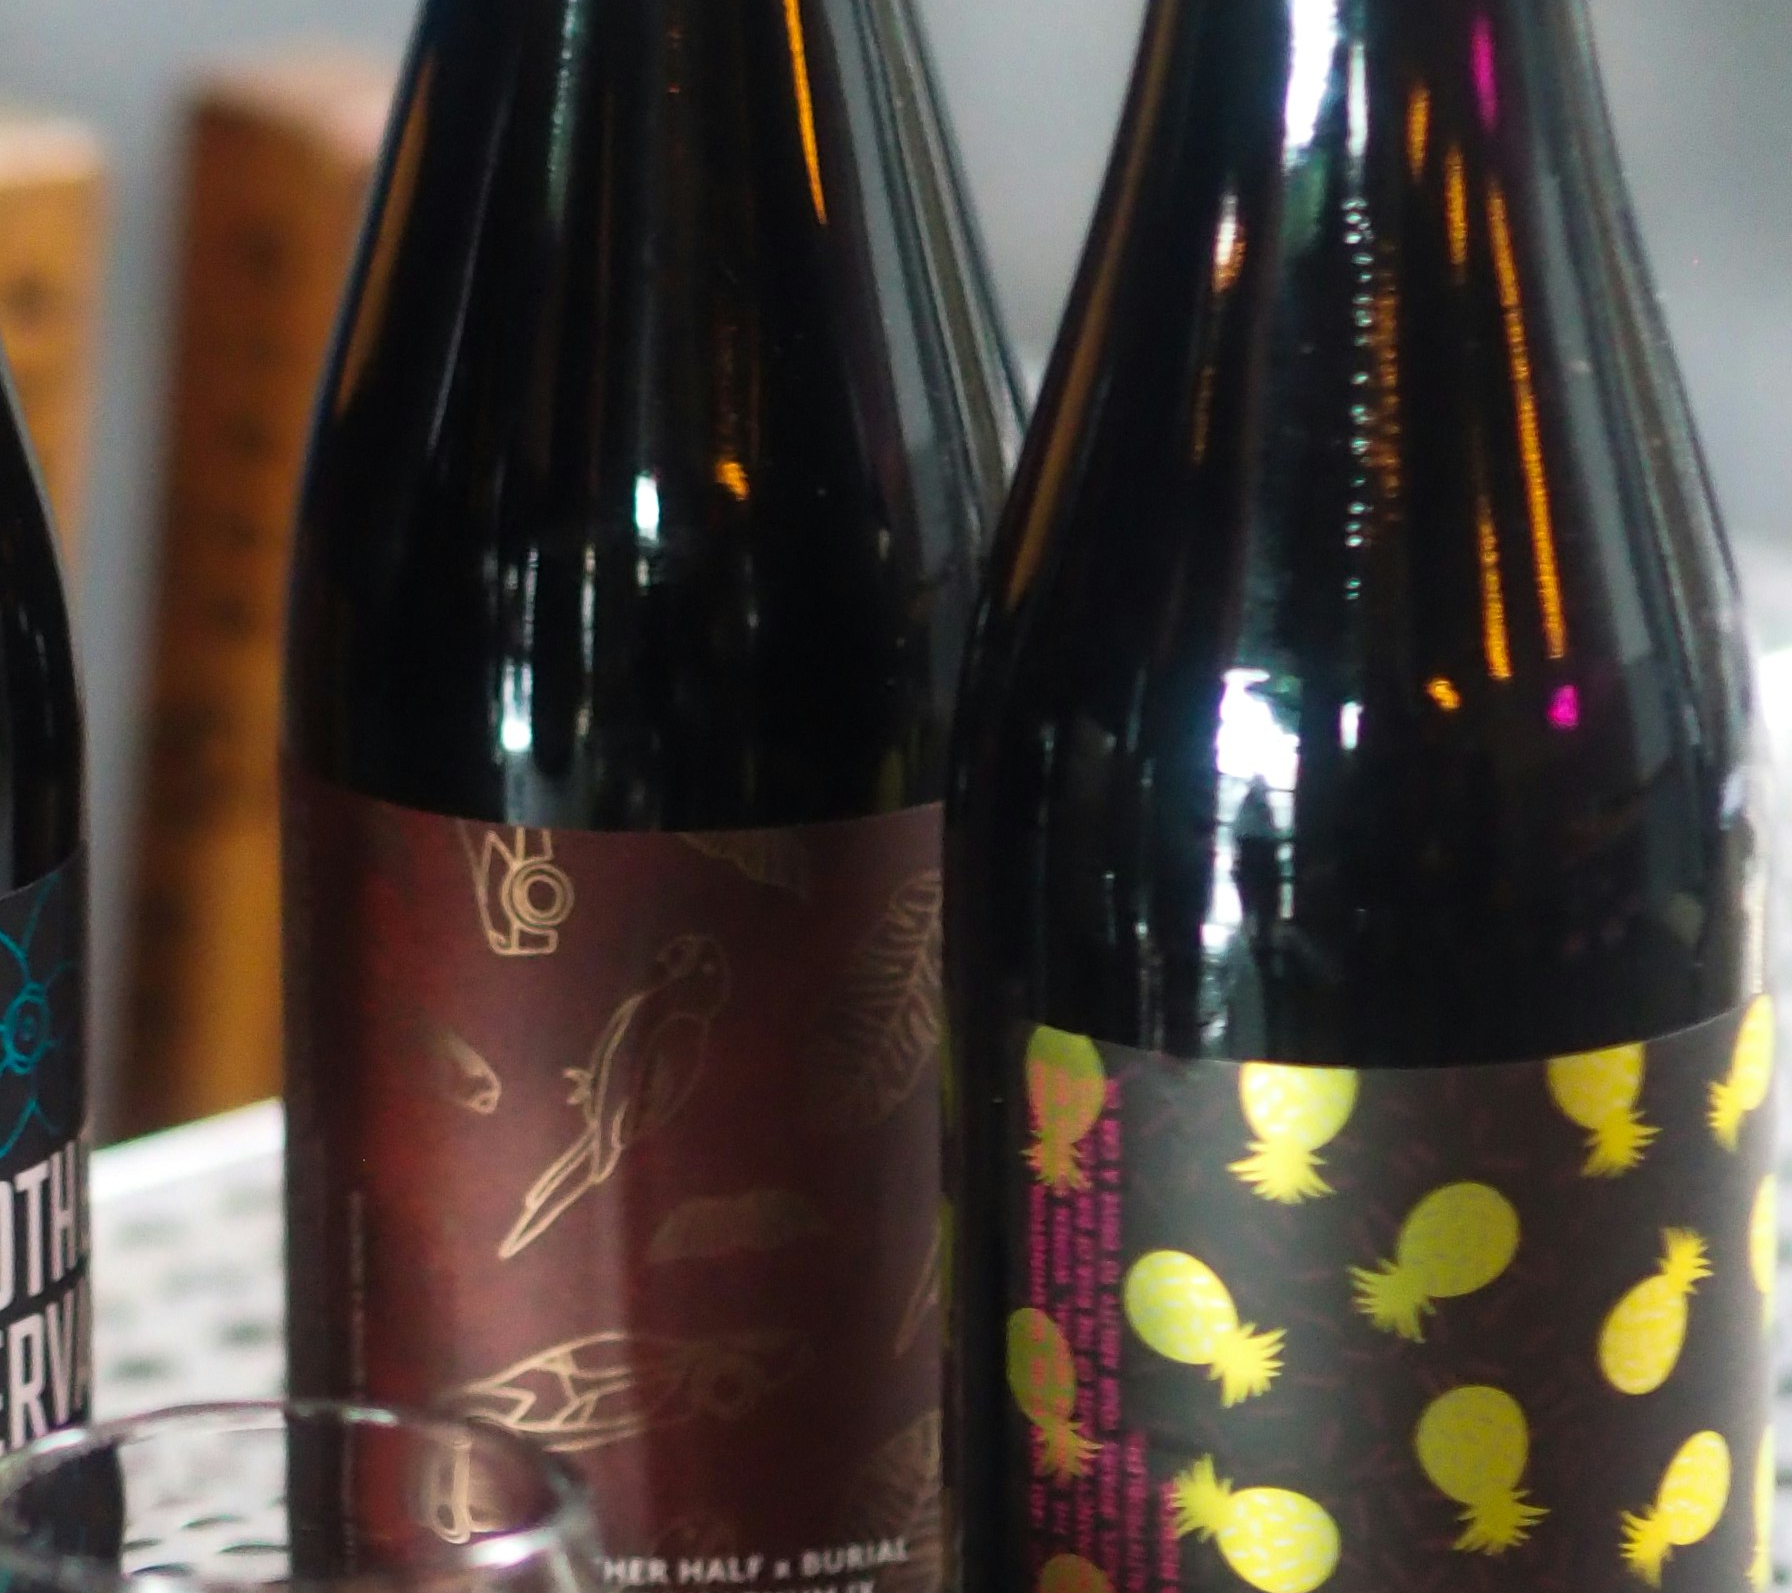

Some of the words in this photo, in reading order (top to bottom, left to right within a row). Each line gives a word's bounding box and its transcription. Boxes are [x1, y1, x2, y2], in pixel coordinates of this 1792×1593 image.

[603, 1556, 669, 1584] HER
[678, 1553, 764, 1584] HALF
[801, 1537, 909, 1578] BURIAL
